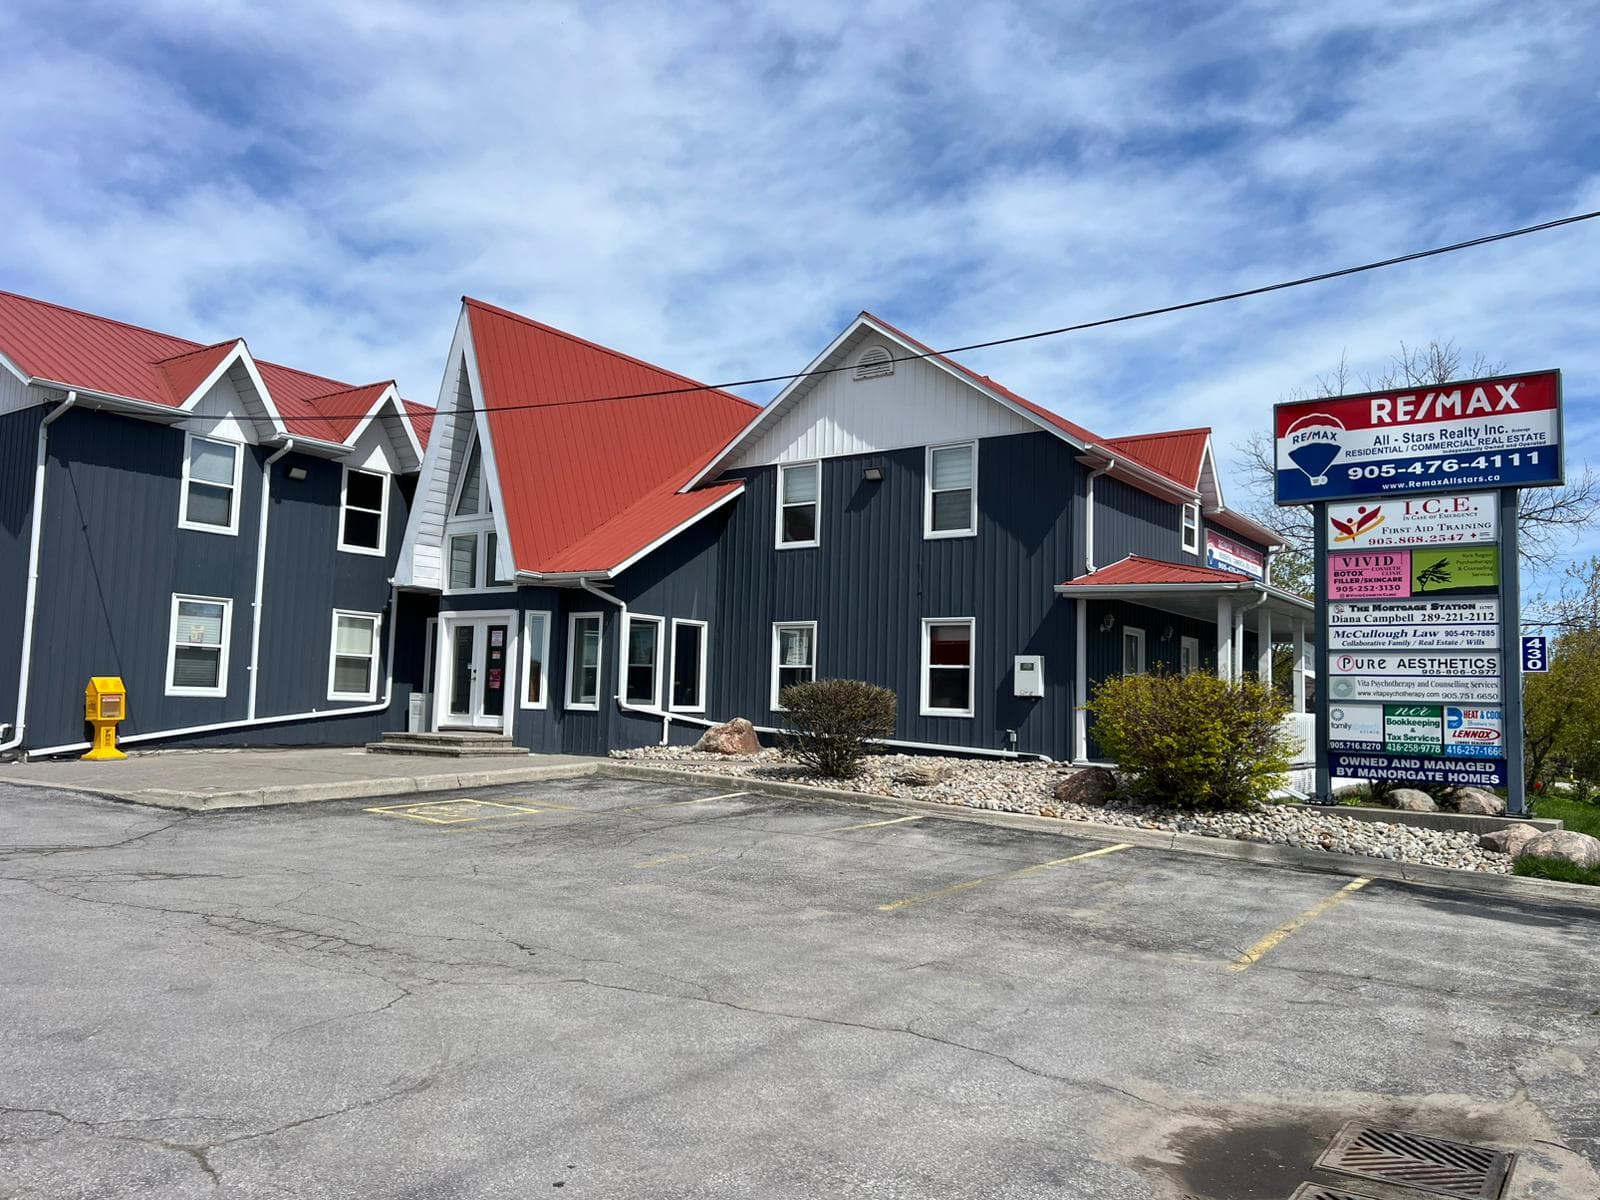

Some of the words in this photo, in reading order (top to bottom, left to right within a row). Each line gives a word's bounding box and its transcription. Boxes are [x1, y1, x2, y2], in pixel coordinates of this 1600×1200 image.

[1370, 383, 1520, 424] RE/MAX
[1292, 431, 1337, 445] RE/MAX
[1373, 434, 1390, 446] All
[1402, 432, 1435, 443] Stars
[1440, 427, 1480, 440] Realty
[1485, 424, 1508, 435] Inc.
[1345, 445, 1404, 458] RESIDENTIAL
[1411, 439, 1475, 452] COMMERCIAL
[1478, 436, 1504, 446] REAL
[1507, 432, 1546, 443] ESTATE
[1347, 450, 1539, 480] 905-476-4111
[1403, 497, 1478, 515] I.C.E.
[1382, 526, 1412, 535] FIRST
[1414, 525, 1434, 533] AID
[1437, 521, 1492, 532] TRAINING
[1368, 533, 1464, 545] 905.868.2547
[1342, 555, 1394, 567] VIVID
[1333, 570, 1364, 578] BOTOX
[1333, 576, 1403, 585] FILLER/SKINCARE
[1349, 604, 1370, 613] THE
[1372, 604, 1427, 612] MORTGAGE
[1430, 603, 1476, 611] STATION
[1332, 614, 1361, 623] Diana
[1364, 613, 1414, 624] Campbell
[1421, 612, 1495, 622] 289-221-2112
[1333, 629, 1408, 640] McCullough
[1412, 629, 1440, 638] Law
[1445, 629, 1496, 637] 905-476-7885
[1388, 639, 1410, 648] Family
[1466, 638, 1485, 646] Wills
[1526, 638, 1542, 670] 430
[1397, 658, 1497, 669] AESTHETICS
[1357, 679, 1370, 687] Vita
[1370, 679, 1416, 689] Psychotherapy
[1417, 680, 1429, 688] and
[1430, 680, 1470, 689] Counselling
[1470, 680, 1499, 689] Services
[1357, 689, 1440, 698] www.vitapsychotherapy.com
[1441, 692, 1499, 700] 905.751.6650
[1463, 710, 1479, 719] HEAT
[1331, 722, 1352, 731] family
[1386, 717, 1441, 729] Bookkeeping
[1387, 733, 1402, 741] Tax
[1403, 733, 1441, 742] Services
[1452, 730, 1492, 739] LENNOX
[1330, 741, 1381, 751] 905.716.8270
[1339, 756, 1388, 767] OWNED
[1391, 759, 1420, 769] AND
[1424, 760, 1496, 772] MANAGED
[1336, 767, 1353, 776] BY
[1357, 768, 1444, 781] MANORGATE
[1447, 773, 1501, 784] HOMES
